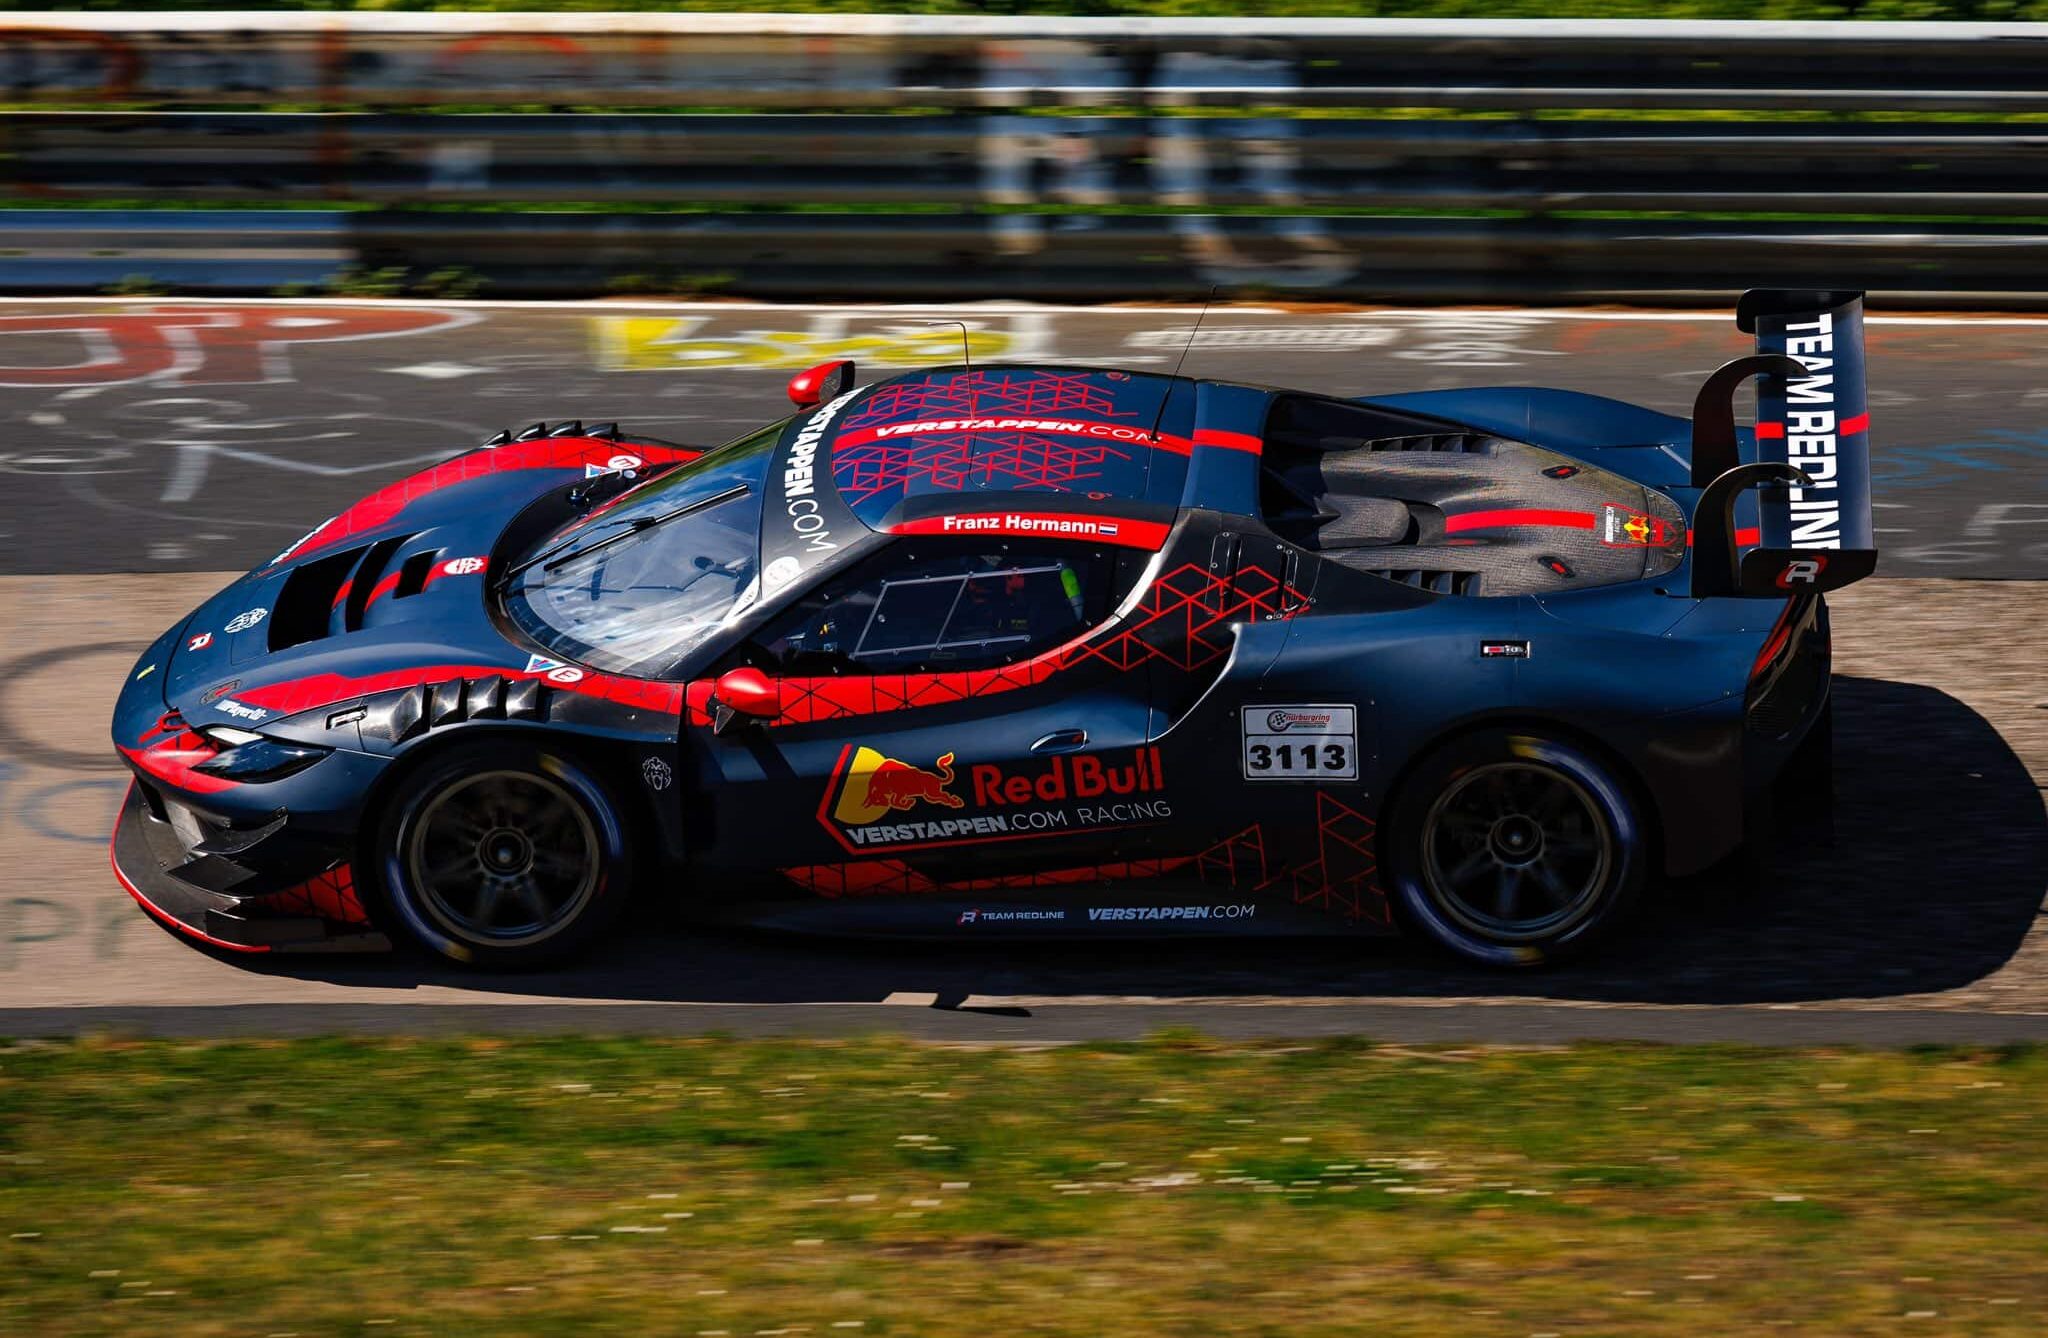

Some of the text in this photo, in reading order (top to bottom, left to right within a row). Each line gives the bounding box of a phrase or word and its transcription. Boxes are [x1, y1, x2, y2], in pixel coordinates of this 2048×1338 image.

[1786, 313, 1841, 550] TEAM REDLIN
[943, 514, 1097, 534] Franz Hermann
[1249, 744, 1346, 771] 3113
[971, 746, 1165, 808] Red Bull
[846, 809, 1067, 845] VERSTAPPEN.COM
[1016, 911, 1065, 919] REDLINE
[1088, 904, 1255, 921] VERSTAPPEN.COM
